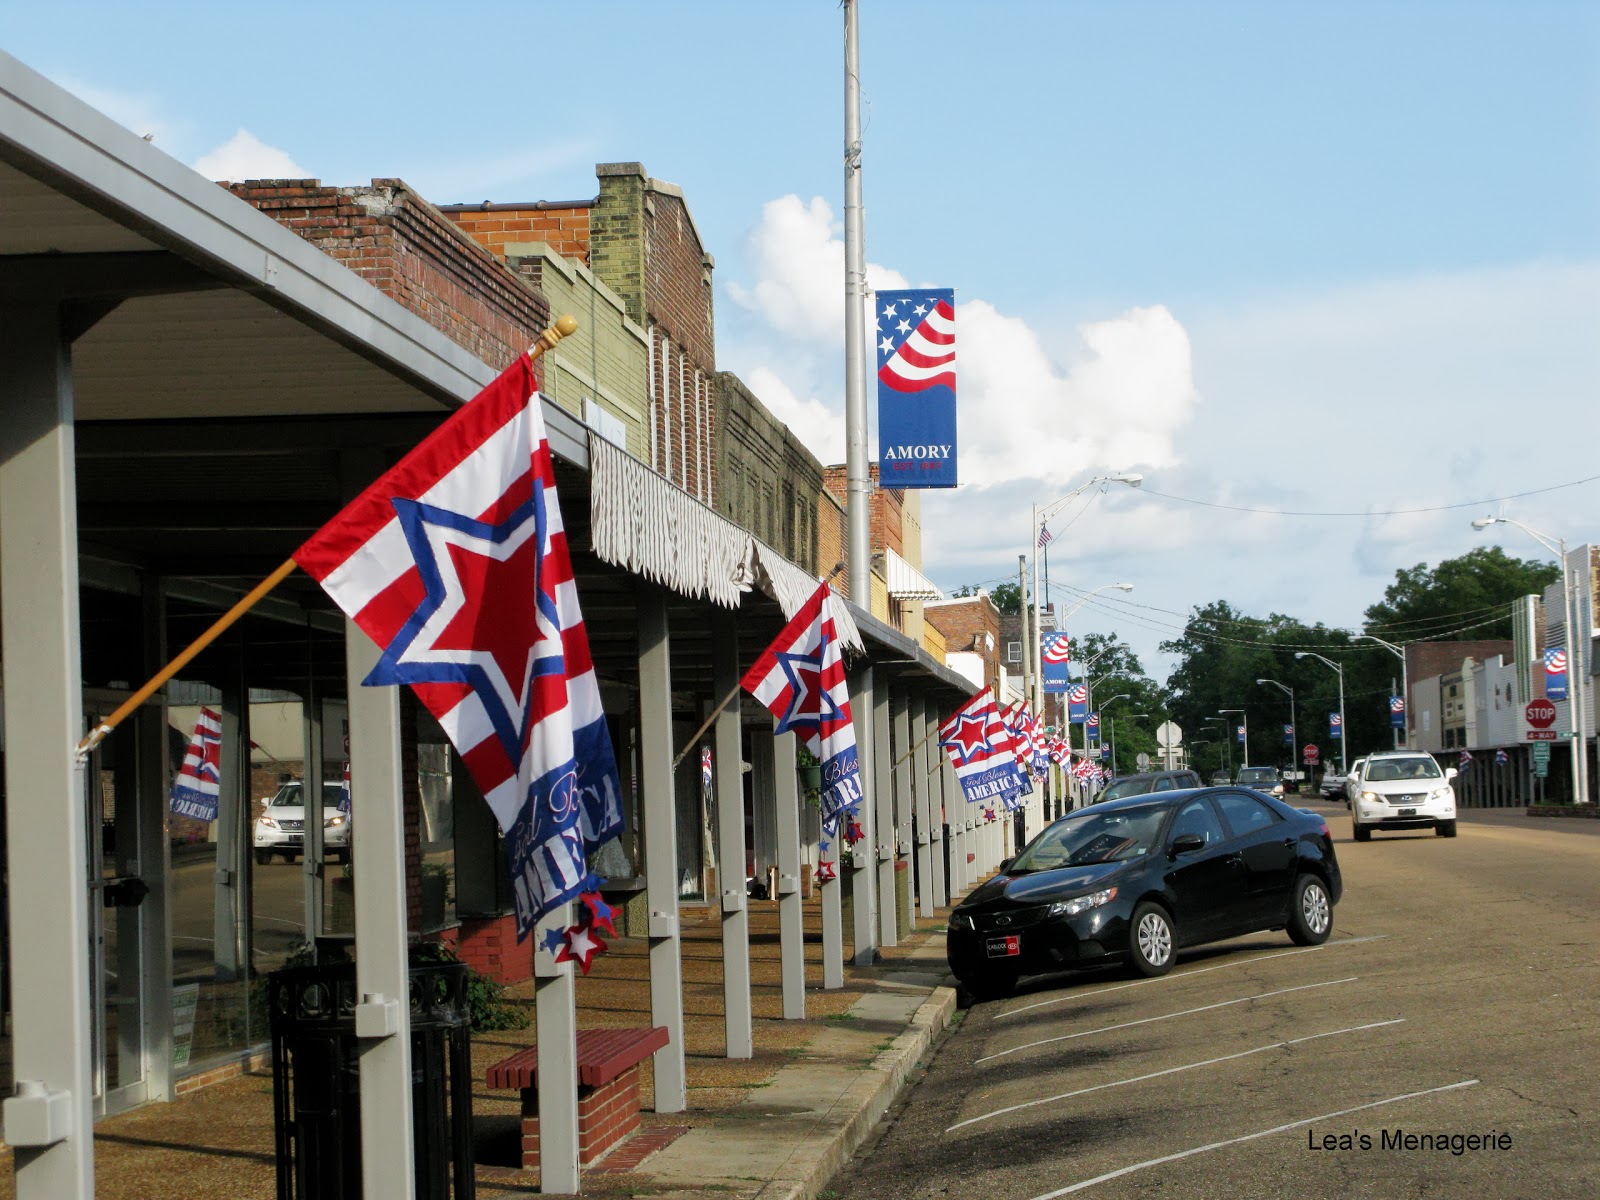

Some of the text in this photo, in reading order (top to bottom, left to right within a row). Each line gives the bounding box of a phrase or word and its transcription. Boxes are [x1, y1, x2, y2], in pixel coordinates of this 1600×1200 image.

[884, 444, 952, 460] AMORY
[1527, 707, 1555, 720] STOP
[965, 769, 1008, 788] God Bless
[967, 773, 1023, 802] AMERICA
